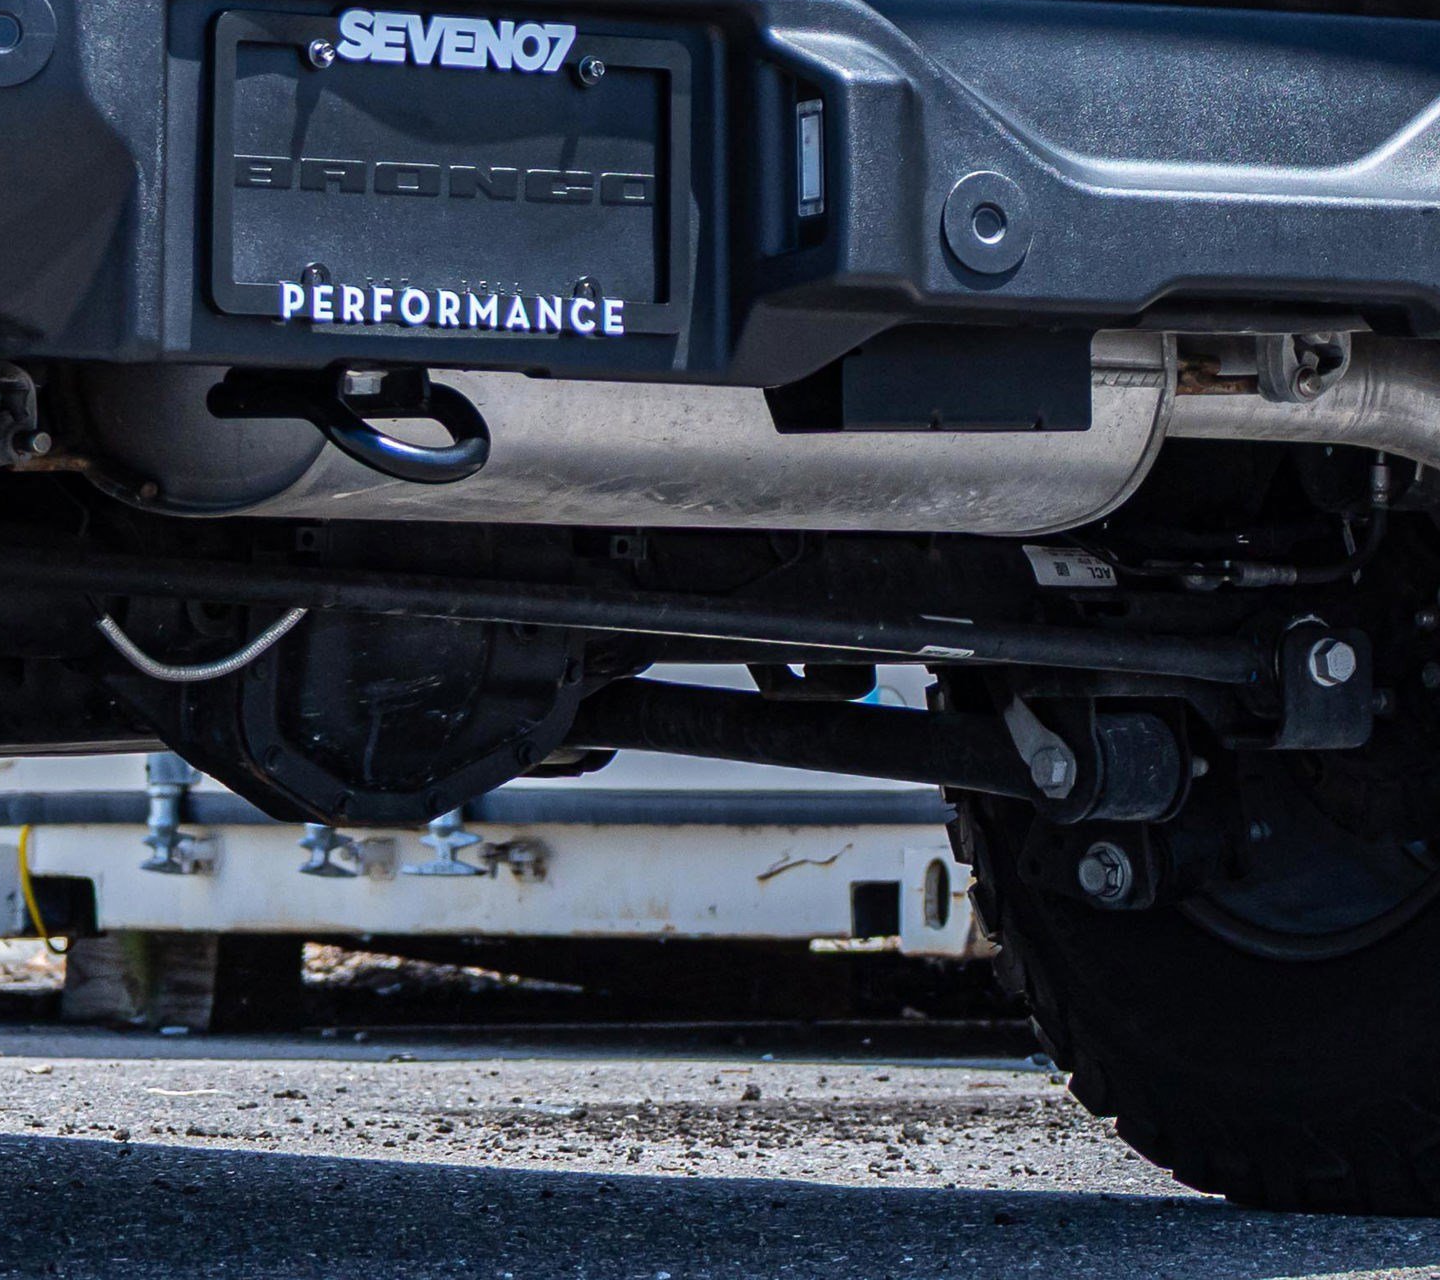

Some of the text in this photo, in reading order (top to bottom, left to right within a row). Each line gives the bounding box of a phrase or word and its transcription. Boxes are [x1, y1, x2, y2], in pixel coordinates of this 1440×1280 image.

[233, 153, 656, 208] BRONCO
[280, 280, 626, 335] PERFORMANCE
[1087, 566, 1112, 579] ACL
